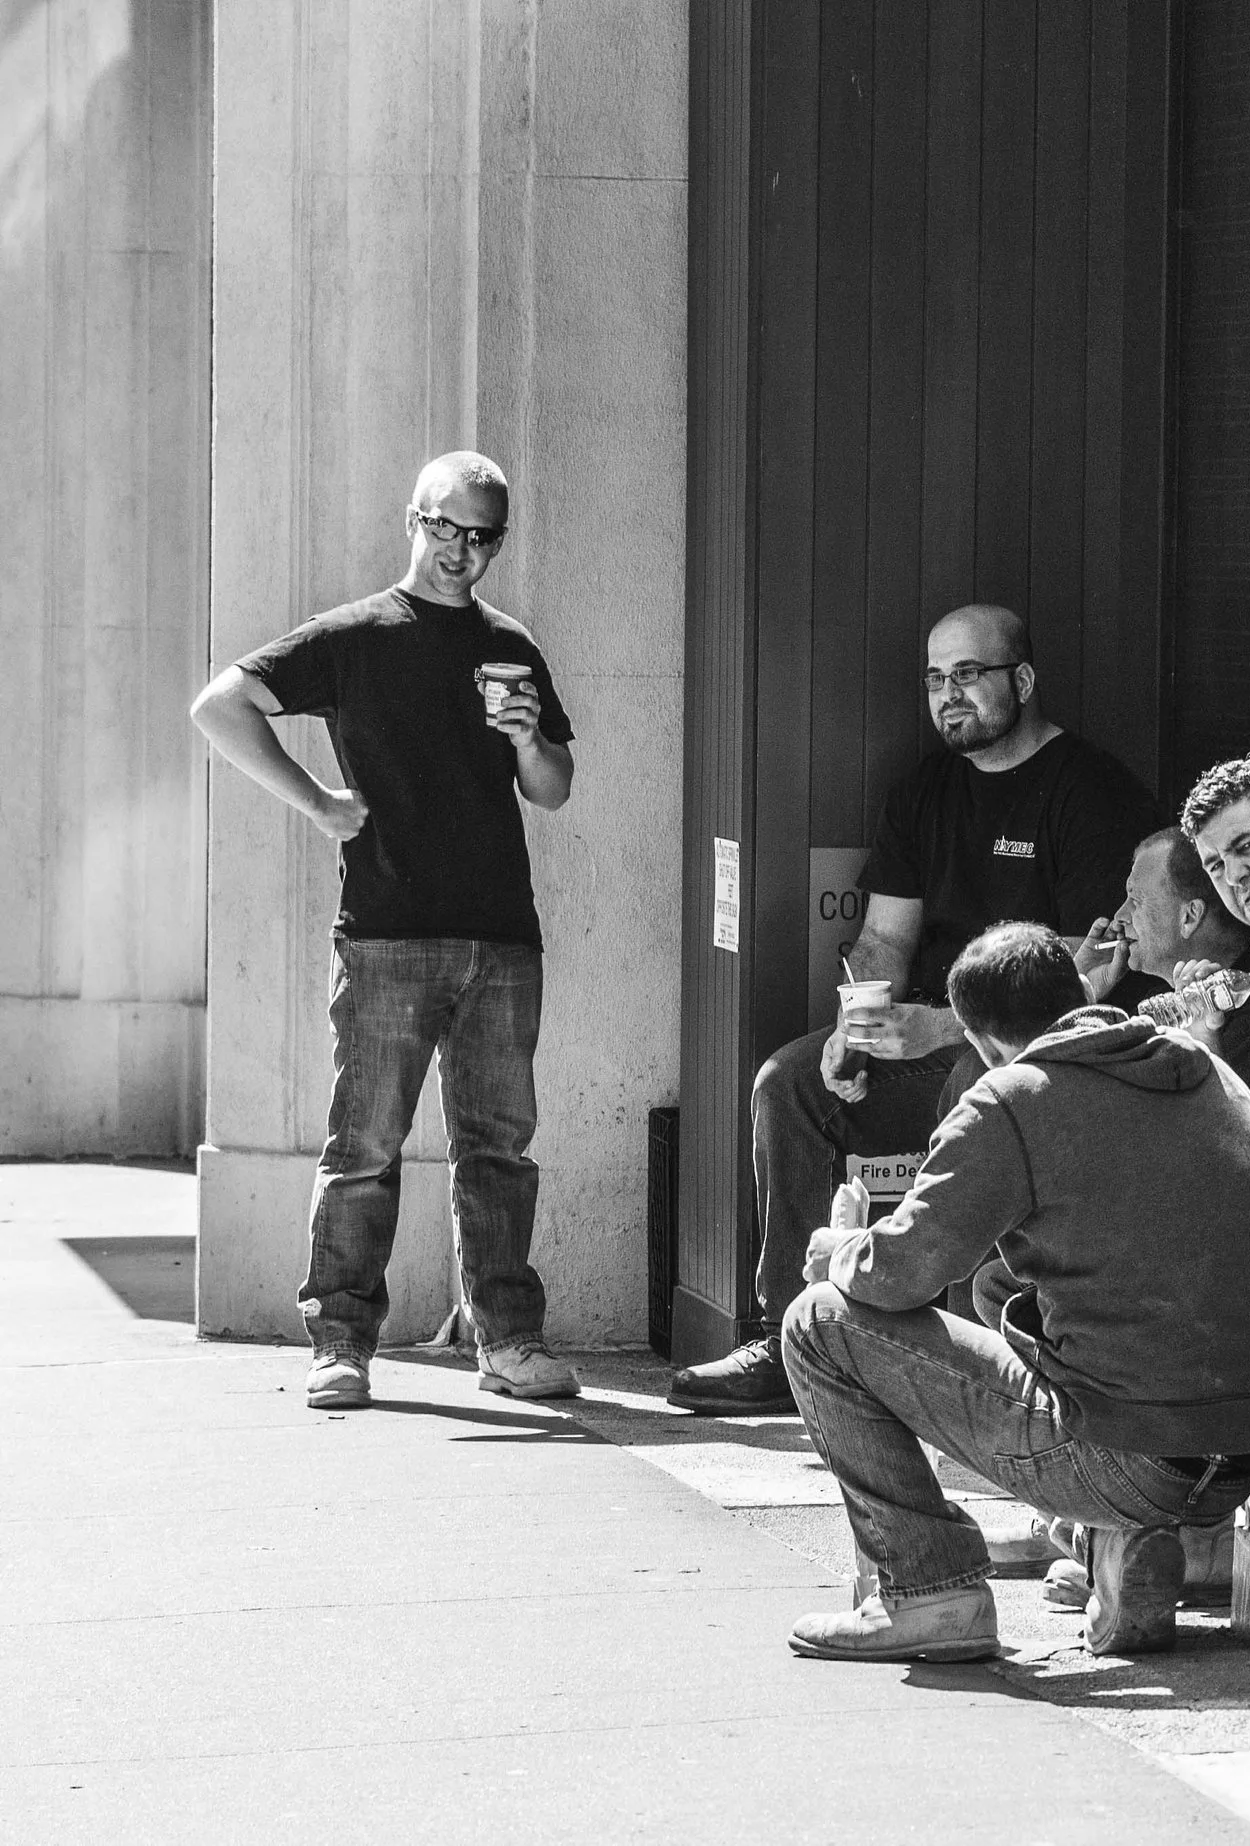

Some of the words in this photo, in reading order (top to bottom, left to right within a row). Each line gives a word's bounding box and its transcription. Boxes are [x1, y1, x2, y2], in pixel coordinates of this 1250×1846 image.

[820, 890, 867, 921] CO
[861, 1164, 891, 1178] Fire
[896, 1164, 919, 1178] De
